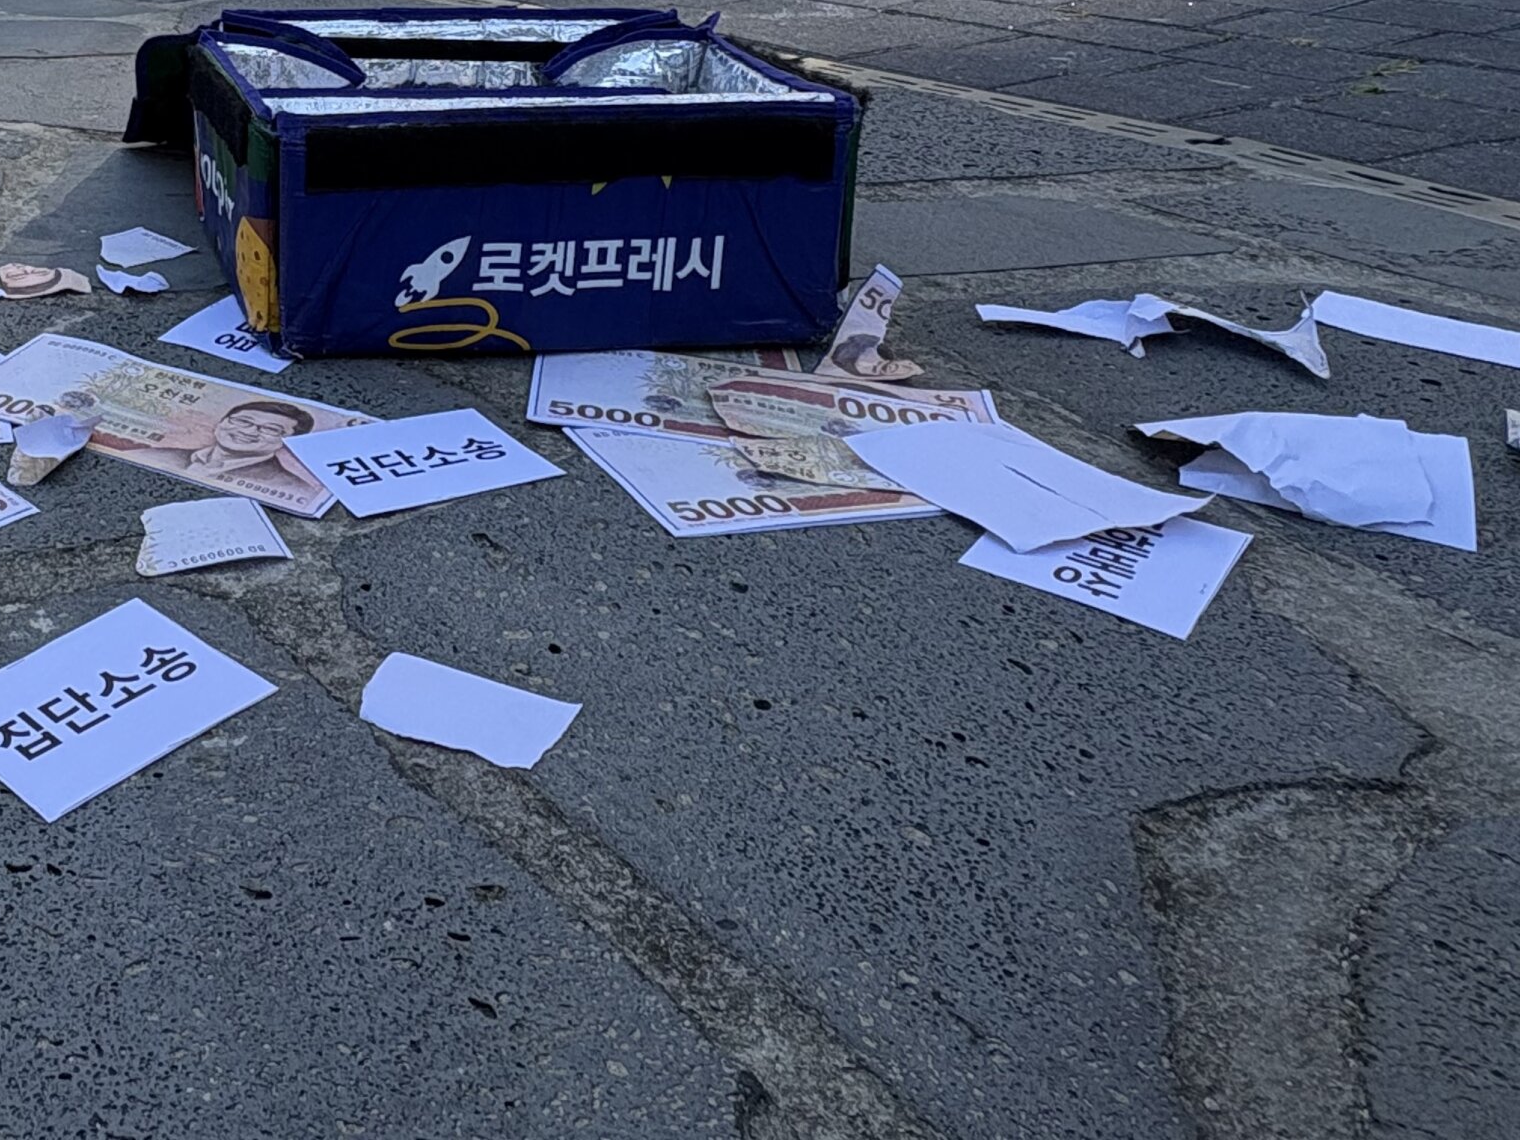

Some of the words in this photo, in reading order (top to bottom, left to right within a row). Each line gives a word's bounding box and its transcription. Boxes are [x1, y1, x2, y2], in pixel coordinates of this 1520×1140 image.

[472, 235, 725, 297] 로켓프레시
[547, 400, 661, 427] 5000
[327, 435, 509, 487] 집단소송
[666, 494, 794, 522] 5000
